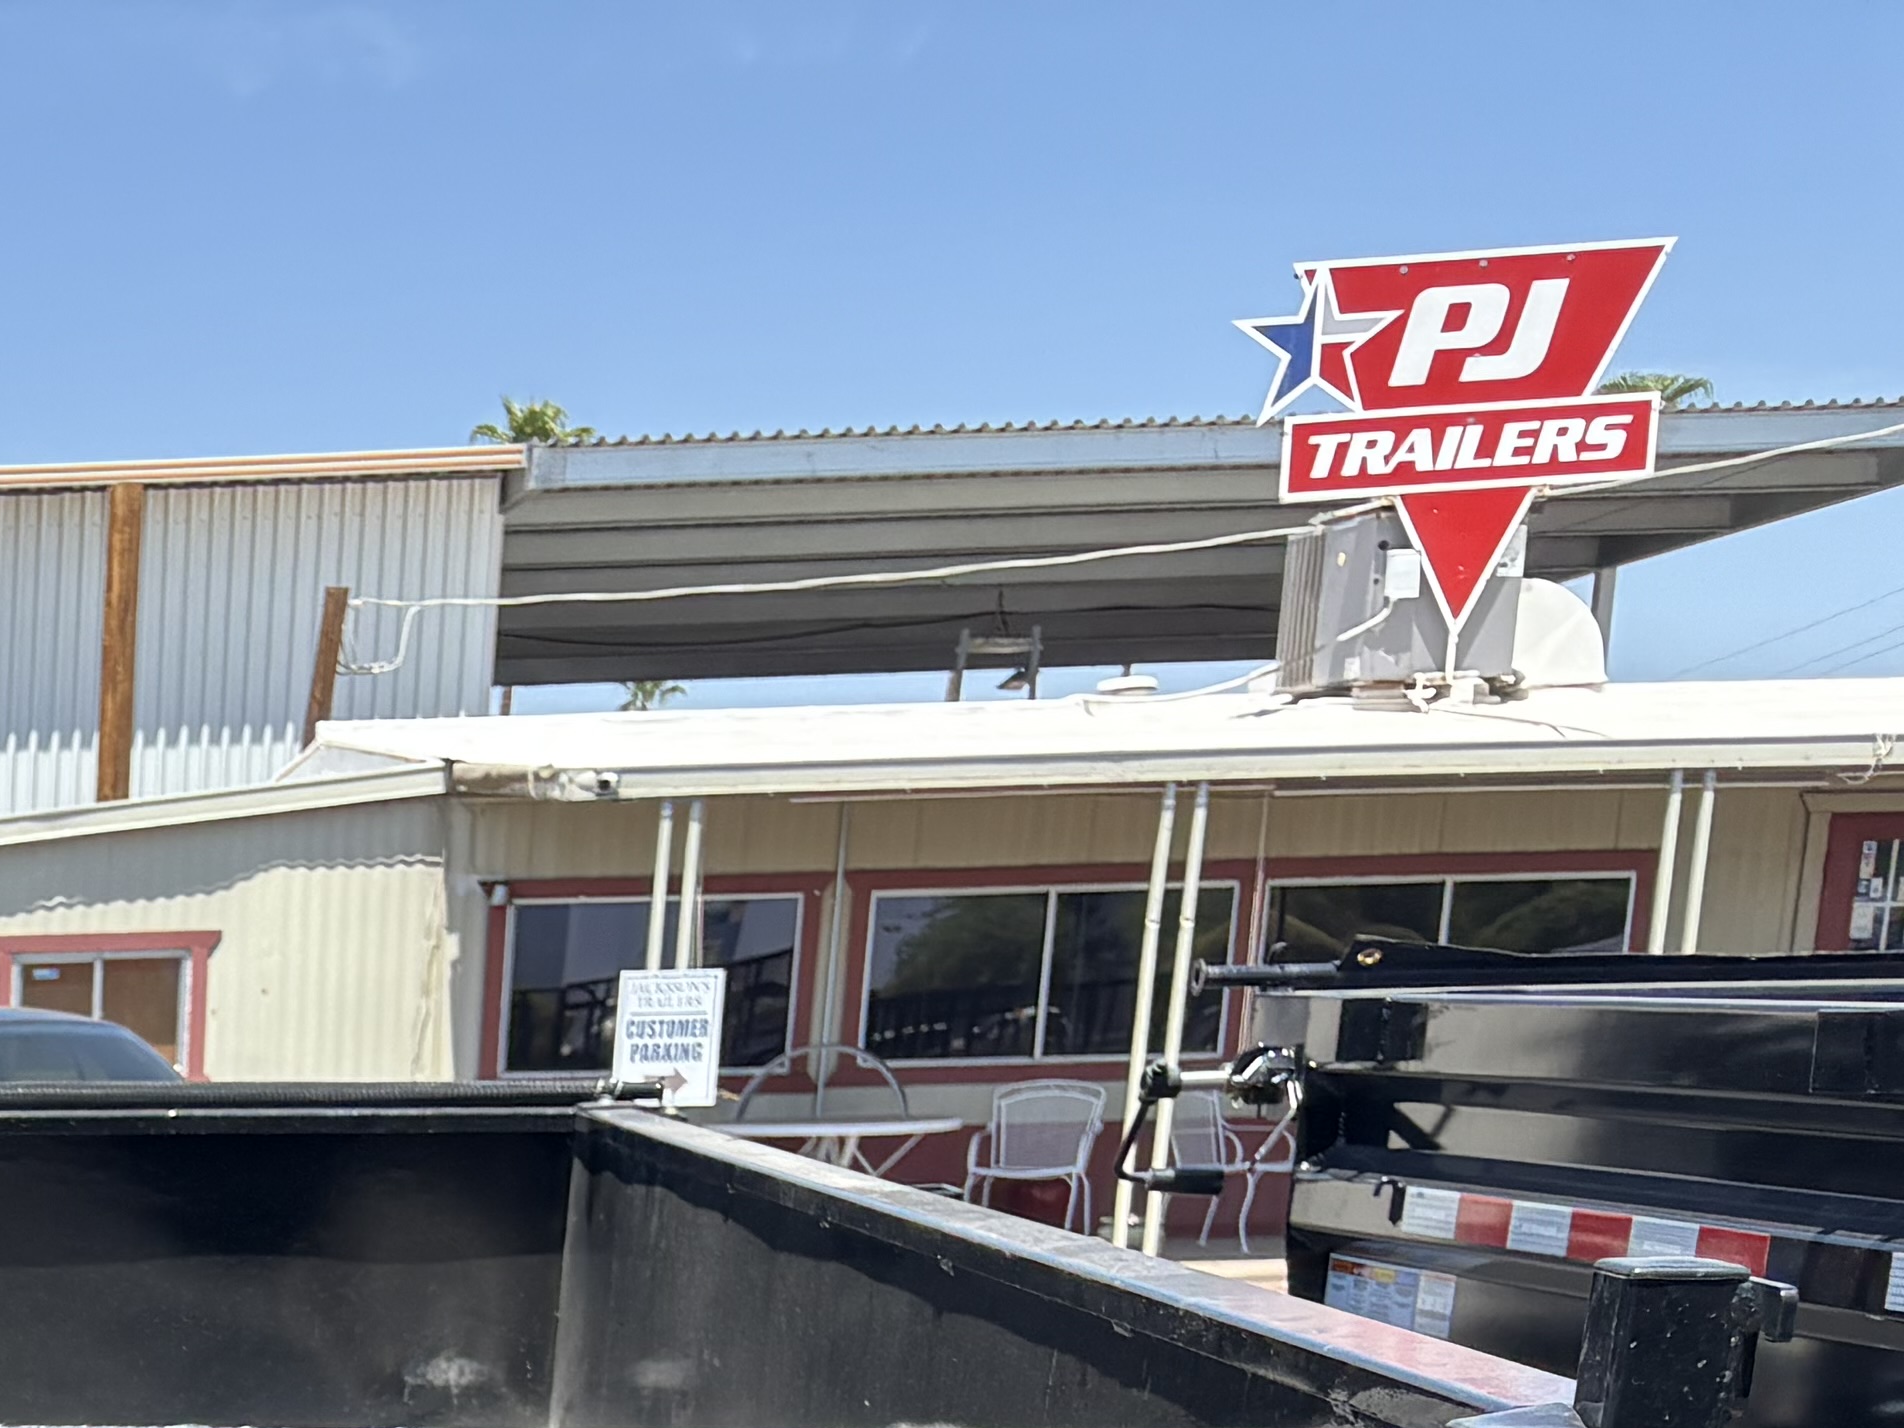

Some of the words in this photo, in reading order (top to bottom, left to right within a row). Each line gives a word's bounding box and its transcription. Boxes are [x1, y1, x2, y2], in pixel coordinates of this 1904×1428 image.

[1388, 278, 1570, 387] PJ
[1307, 414, 1634, 480] TRAILERS
[626, 1018, 709, 1039] CUSTOMER
[630, 1042, 703, 1064] PARKING
